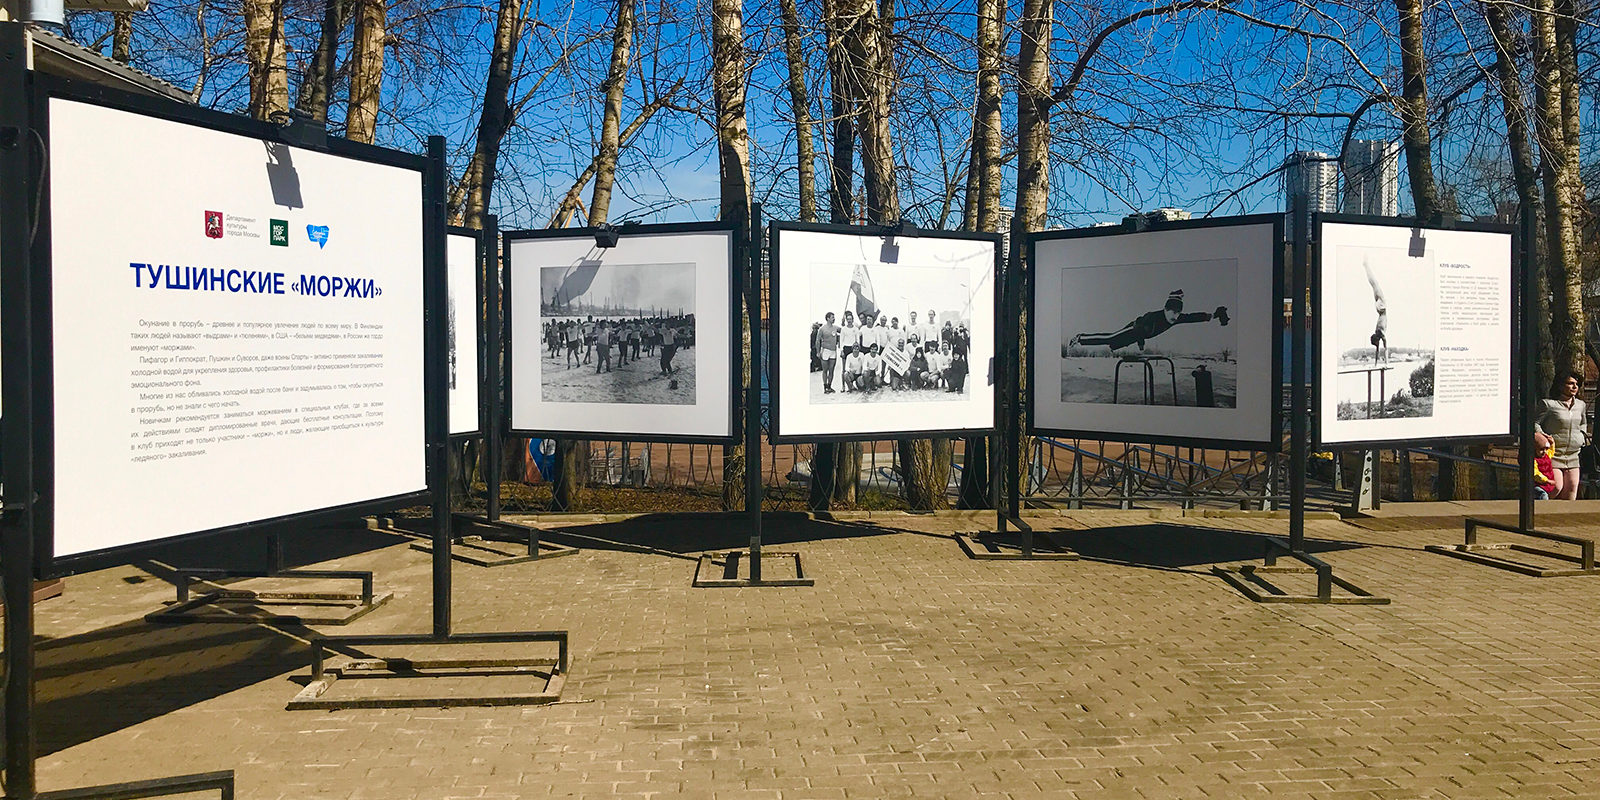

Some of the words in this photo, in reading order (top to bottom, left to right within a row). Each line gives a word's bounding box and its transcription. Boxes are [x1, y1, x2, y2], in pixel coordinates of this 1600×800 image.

[226, 214, 256, 223] Департамент
[130, 263, 285, 294] ТУШИНСКИЕ
[292, 275, 382, 298] «МОРЖИ»
